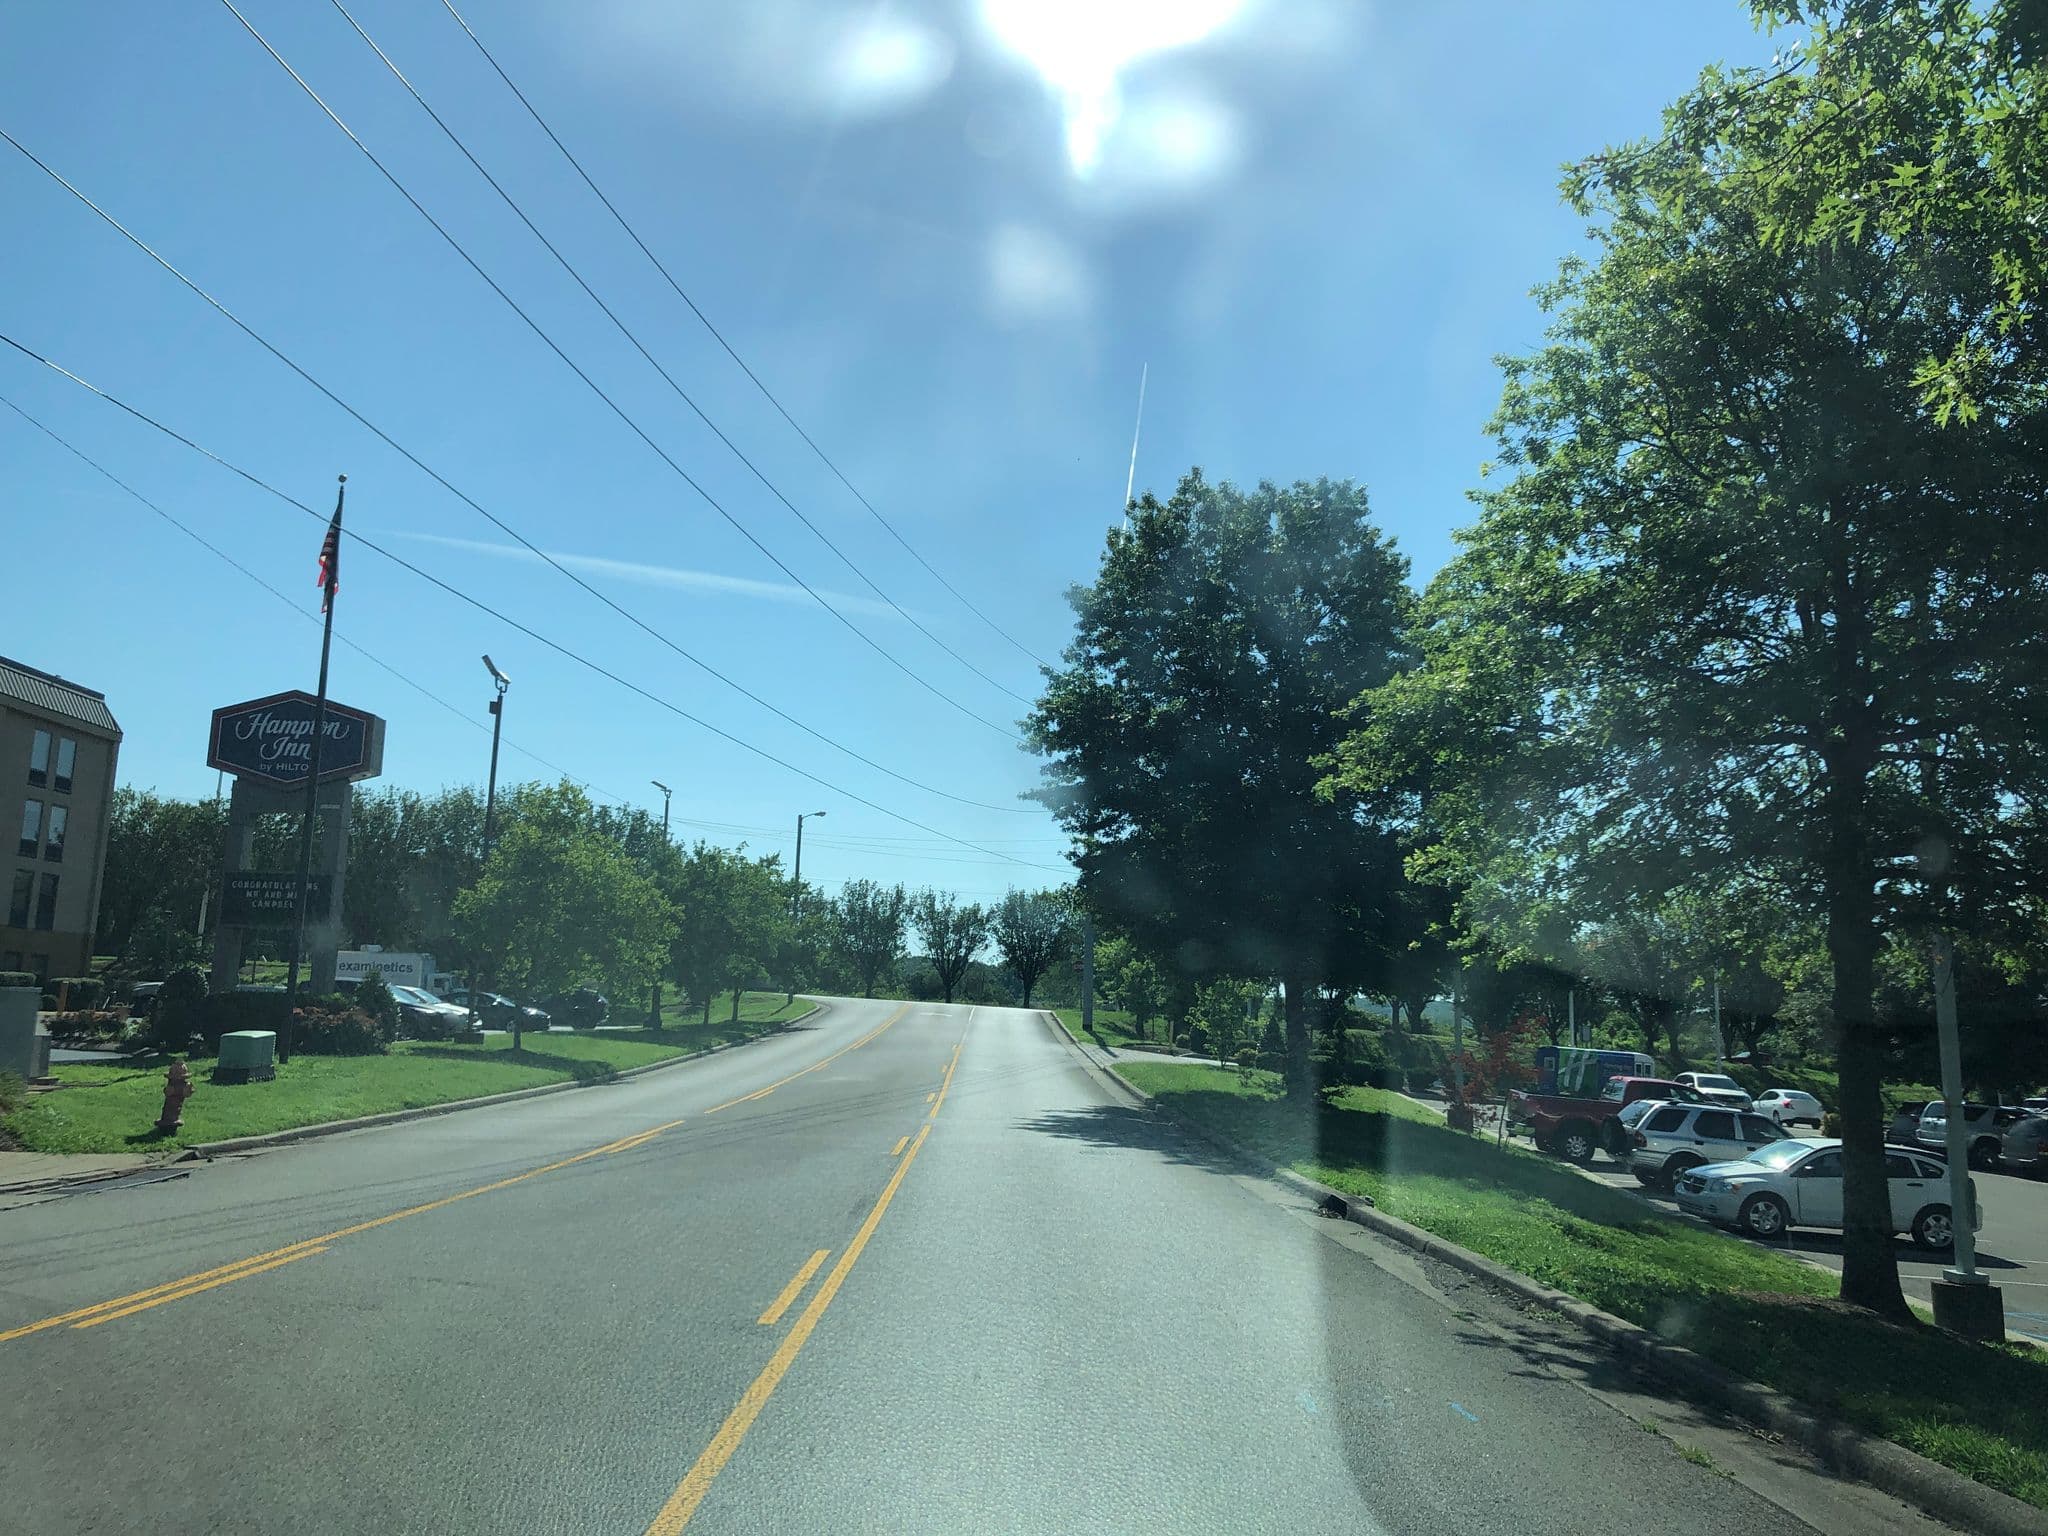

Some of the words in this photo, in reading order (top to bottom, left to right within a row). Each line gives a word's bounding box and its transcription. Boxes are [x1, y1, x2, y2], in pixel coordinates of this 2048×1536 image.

[260, 736, 312, 760] Inn
[260, 762, 273, 773] by
[276, 763, 309, 771] HILTO
[264, 891, 282, 899] AND
[338, 961, 414, 973] examinetics
